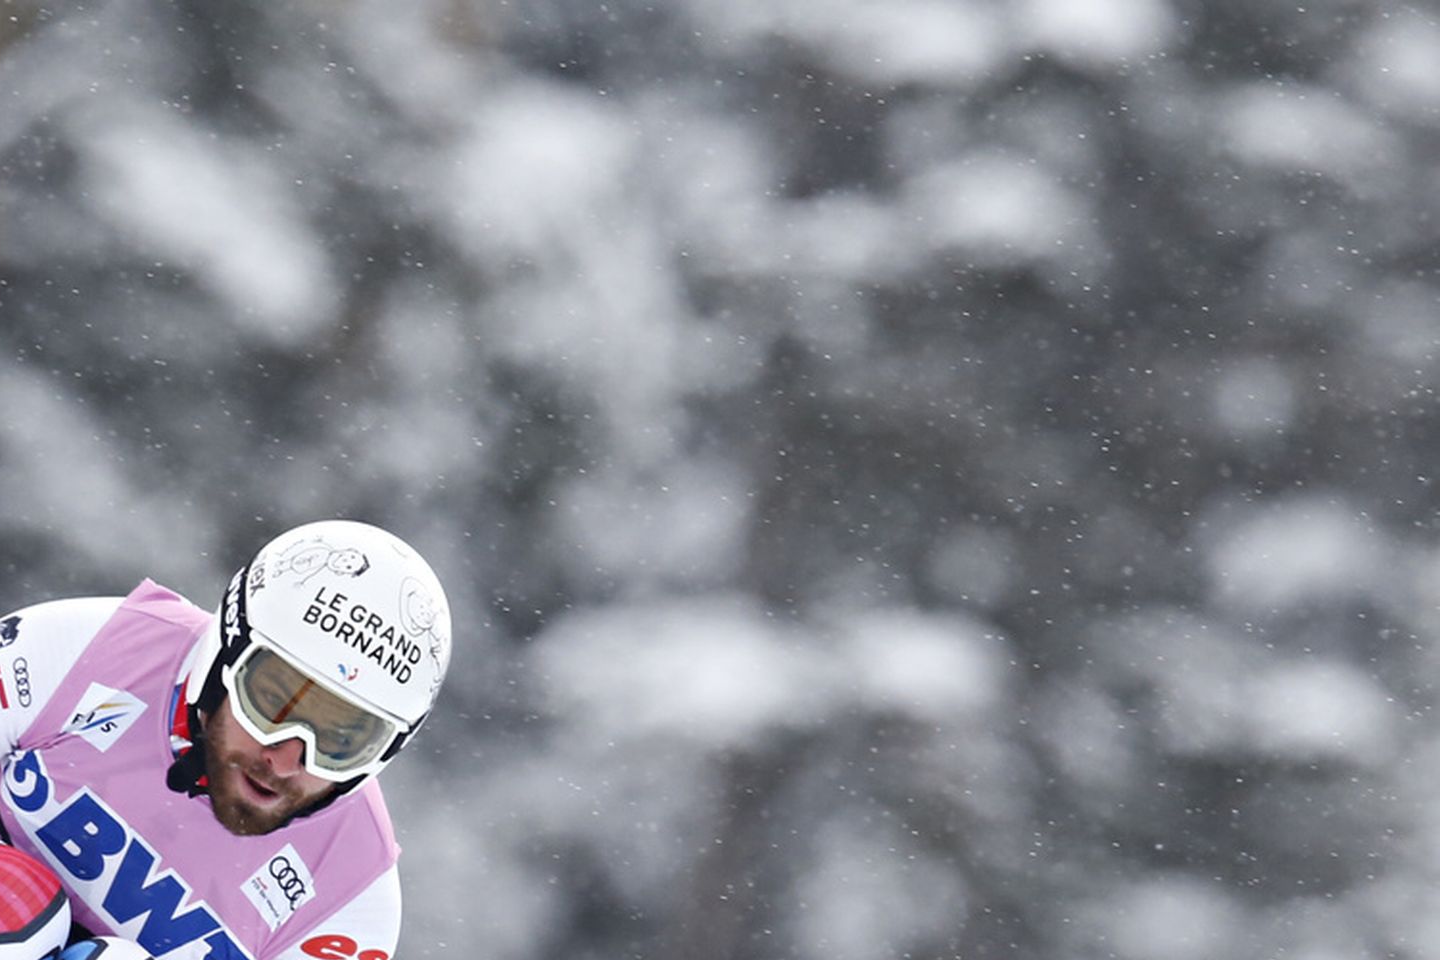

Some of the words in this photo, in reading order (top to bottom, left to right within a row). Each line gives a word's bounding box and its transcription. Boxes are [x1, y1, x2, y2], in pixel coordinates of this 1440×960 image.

[302, 604, 412, 685] BORNAND
[313, 586, 348, 612] LE
[349, 604, 422, 665] GRAND
